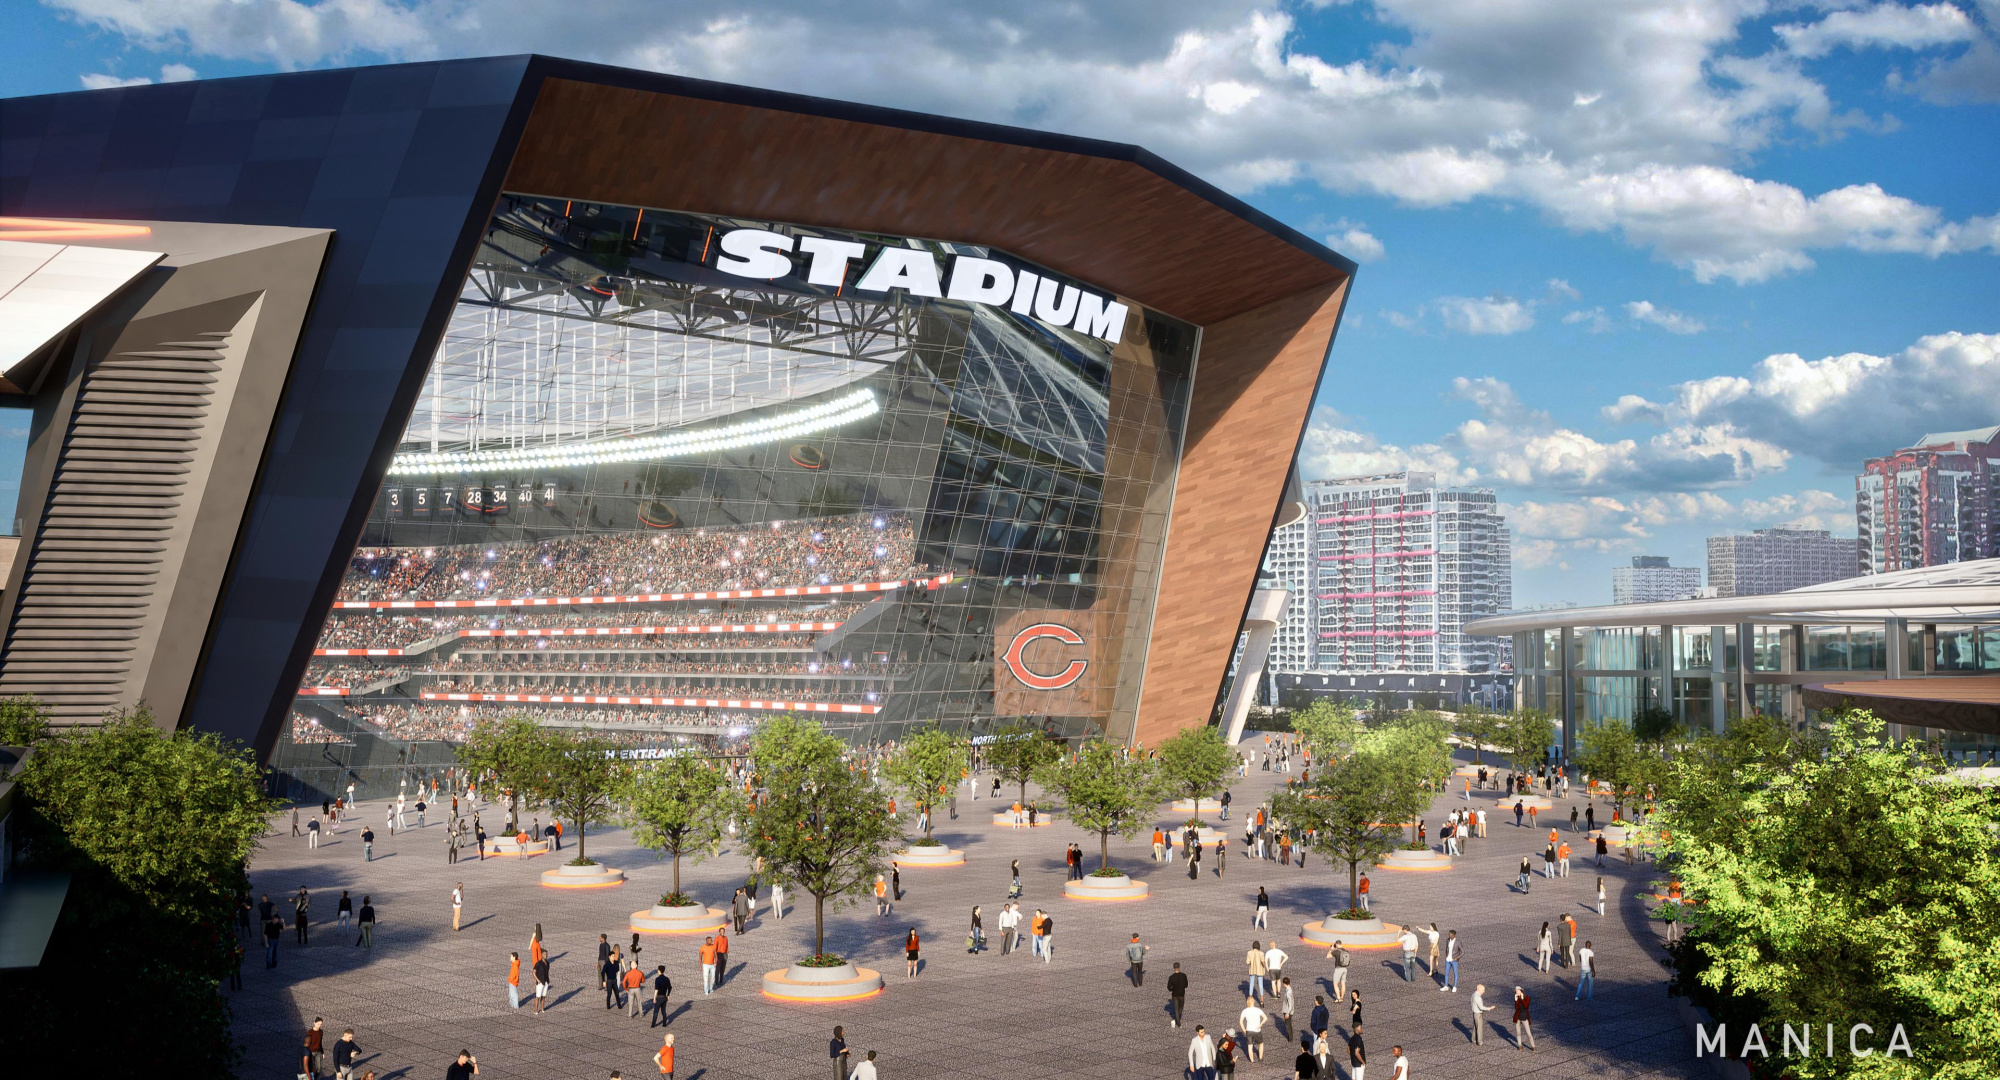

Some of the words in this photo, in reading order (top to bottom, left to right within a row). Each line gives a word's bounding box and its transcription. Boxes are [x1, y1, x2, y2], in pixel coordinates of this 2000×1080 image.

[716, 229, 1129, 344] STADIUM
[391, 494, 399, 506] 3
[418, 493, 426, 505] 5
[444, 492, 452, 504] 7
[467, 491, 482, 504] 28
[493, 491, 507, 503] 34
[519, 490, 532, 502] 40
[544, 488, 555, 500] 41
[971, 735, 997, 746] NORTH
